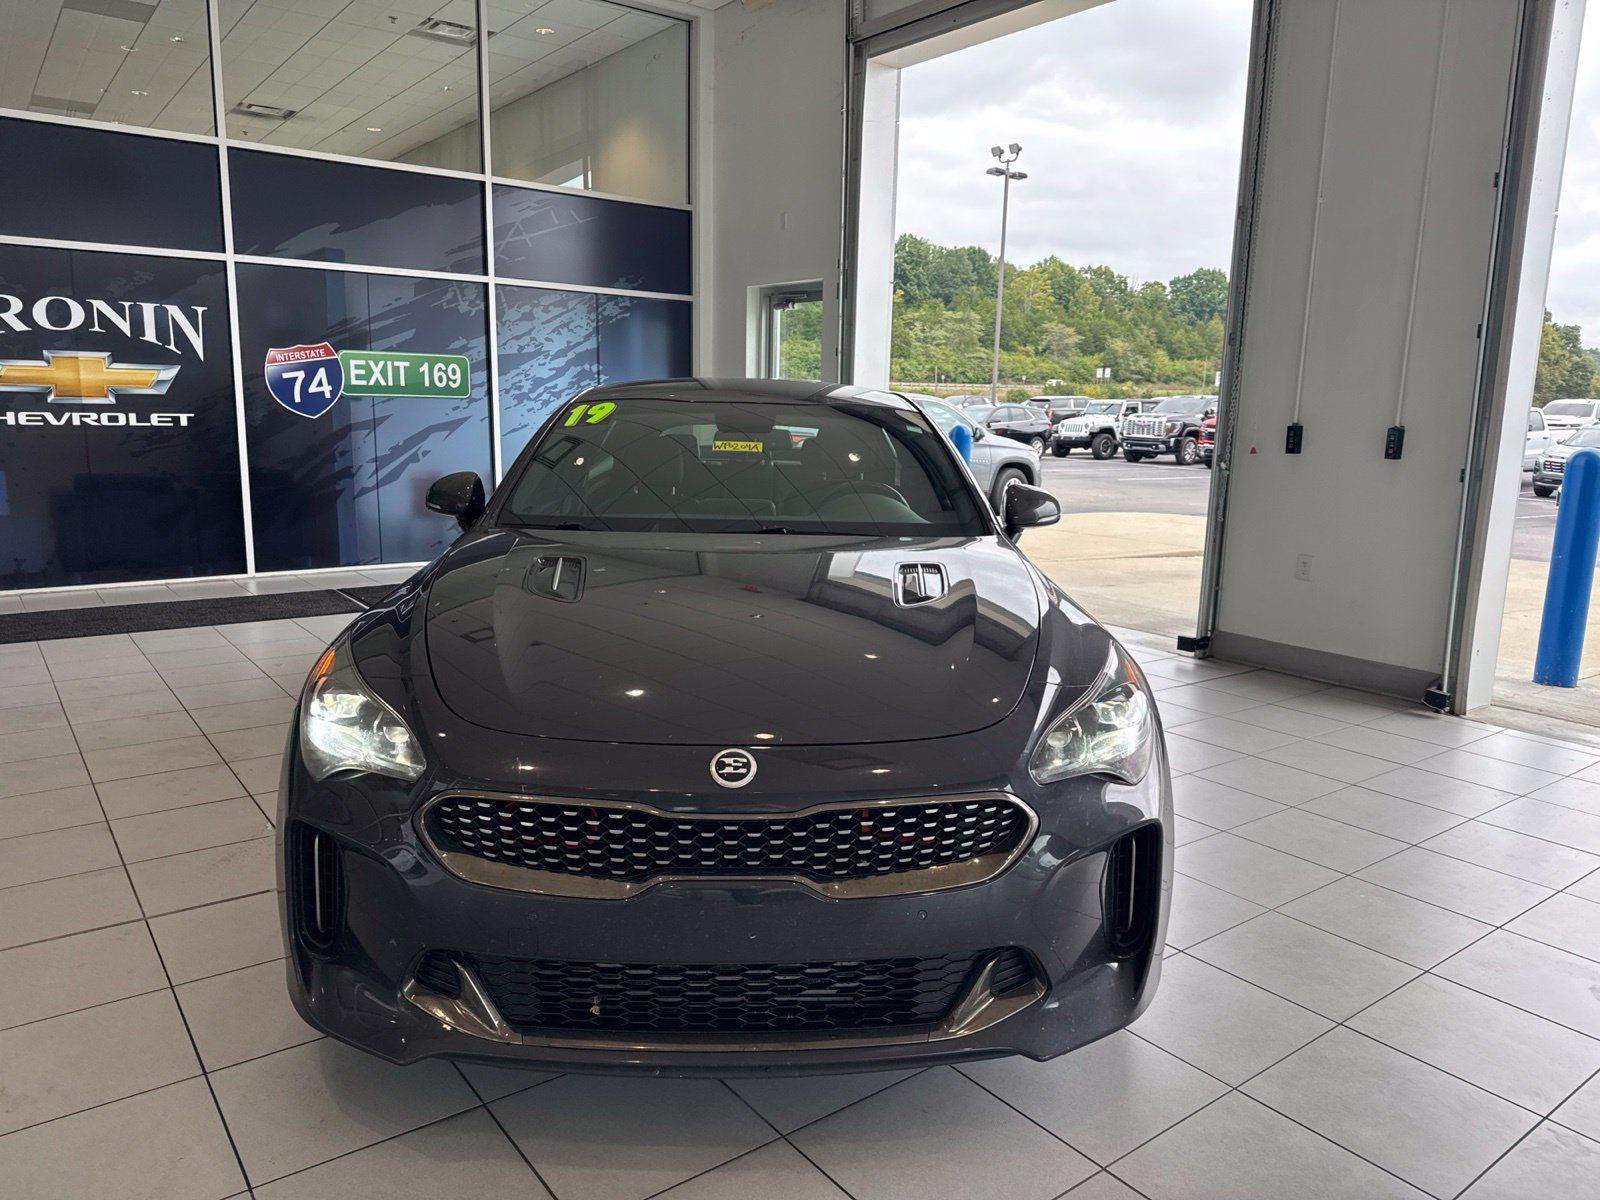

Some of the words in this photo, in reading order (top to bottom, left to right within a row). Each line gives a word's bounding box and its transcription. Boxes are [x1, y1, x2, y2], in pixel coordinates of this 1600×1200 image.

[275, 349, 326, 362] INTERSTATE
[282, 367, 333, 403] 74
[350, 360, 410, 387] EXIT
[419, 362, 462, 388] 169
[564, 402, 617, 427] 19
